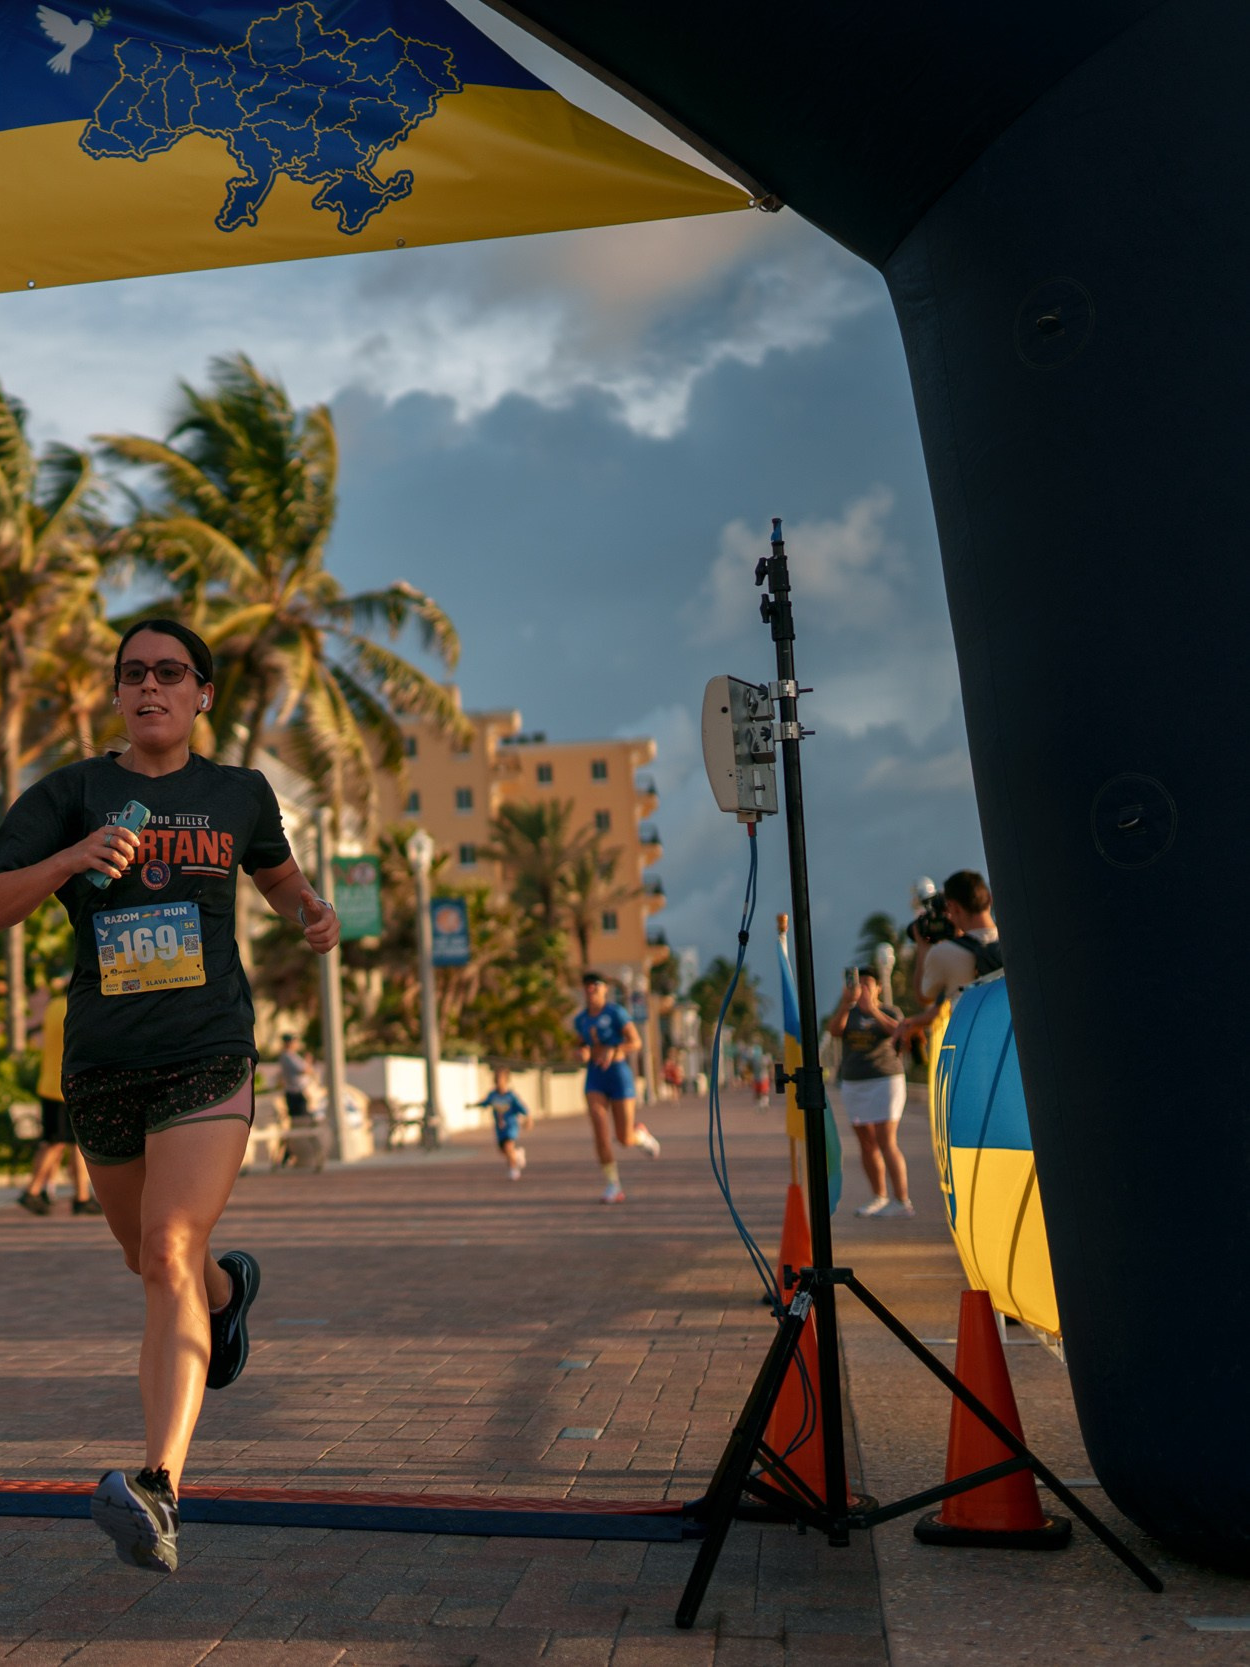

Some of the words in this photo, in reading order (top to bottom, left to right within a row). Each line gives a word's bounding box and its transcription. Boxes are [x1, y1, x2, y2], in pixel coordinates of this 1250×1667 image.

[175, 815, 203, 826] HILLS
[129, 829, 234, 868] RTANS
[104, 912, 139, 925] RAZOM
[163, 907, 187, 917] RUN
[184, 921, 195, 929] 5K
[117, 924, 179, 965] 169
[145, 979, 168, 987] SLAVA
